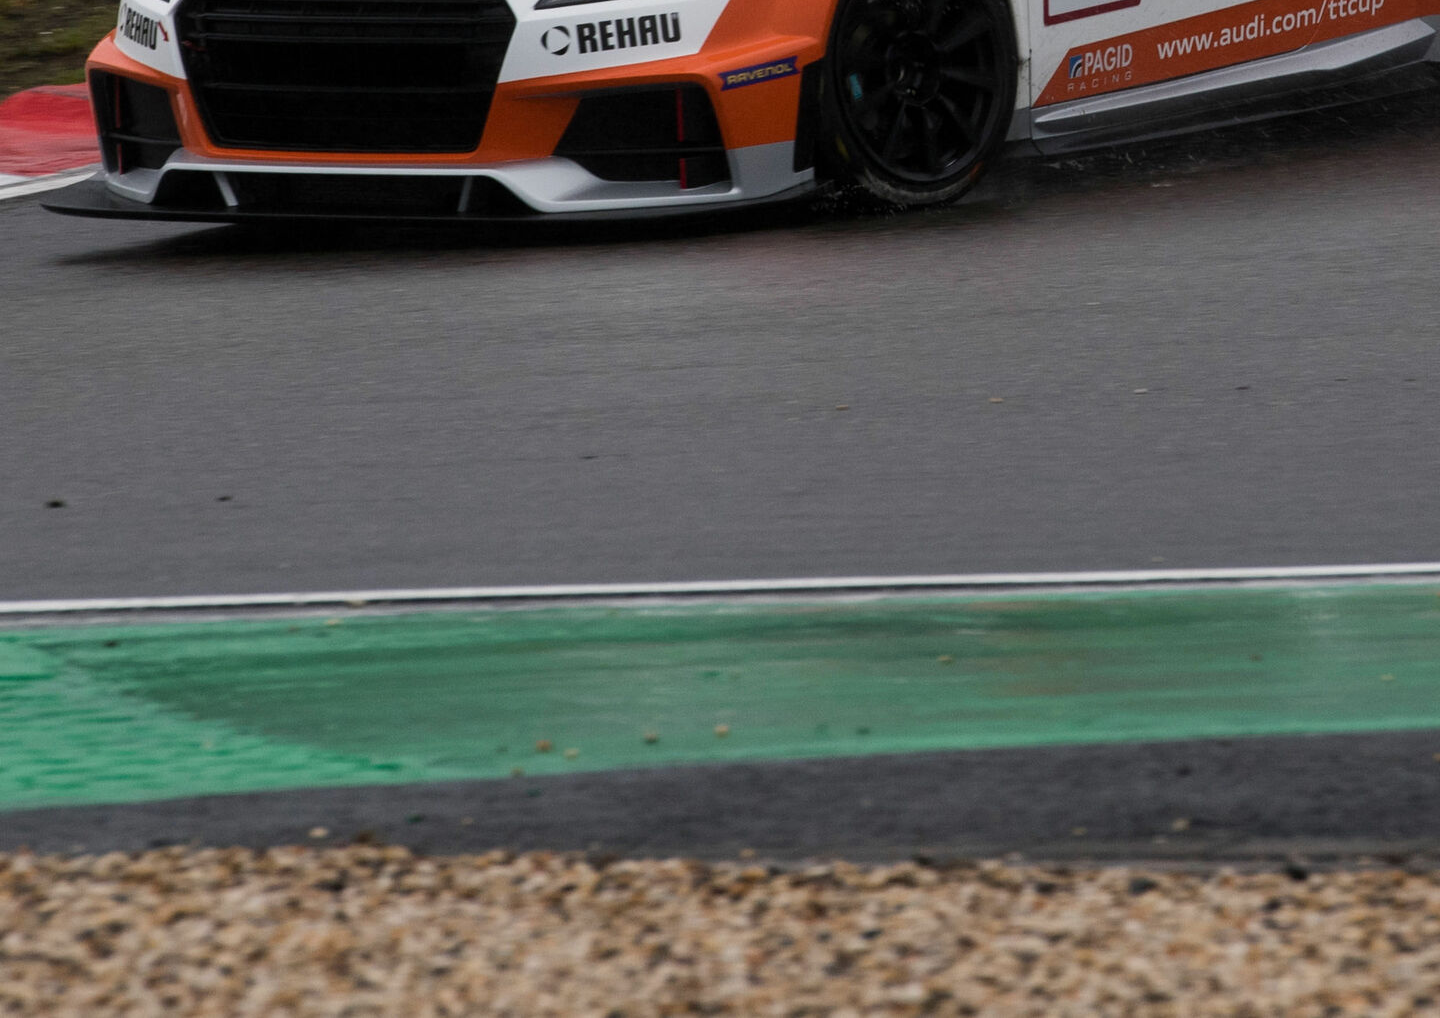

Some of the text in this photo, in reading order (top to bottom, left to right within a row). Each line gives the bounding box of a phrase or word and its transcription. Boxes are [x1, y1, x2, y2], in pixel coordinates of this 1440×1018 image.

[123, 7, 159, 51] REHAU
[576, 12, 683, 55] REHAU
[725, 62, 794, 87] RAVENOL
[1084, 43, 1133, 75] PAGID
[1067, 71, 1133, 92] RACING
